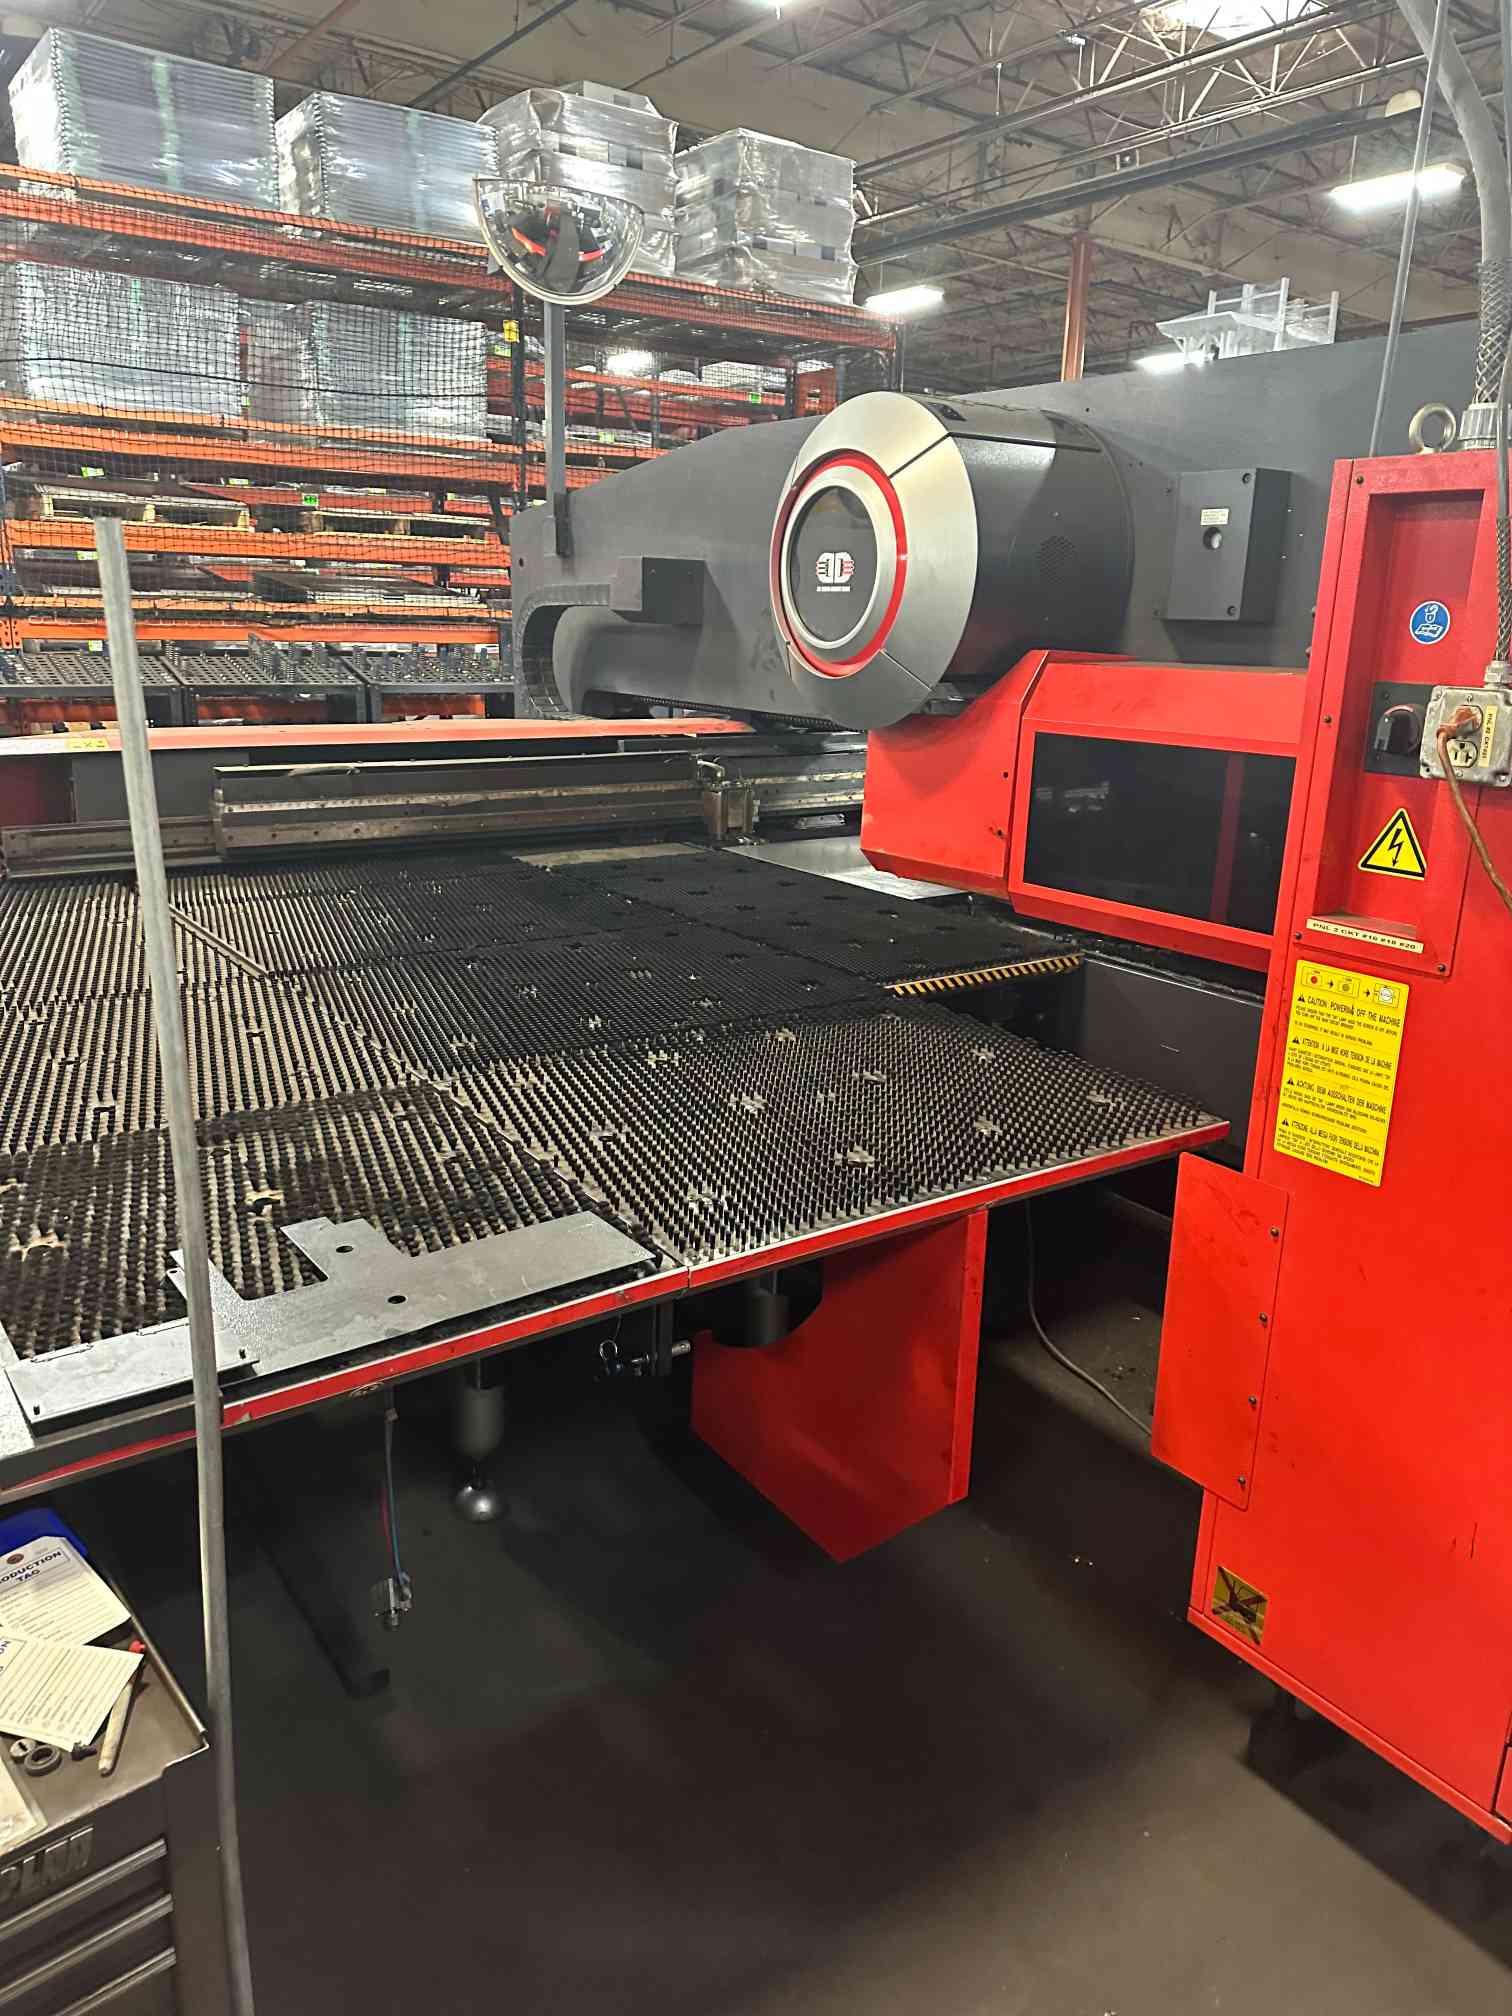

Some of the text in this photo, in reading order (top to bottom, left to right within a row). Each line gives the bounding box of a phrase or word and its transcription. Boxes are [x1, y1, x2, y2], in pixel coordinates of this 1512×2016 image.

[1312, 922, 1330, 931] PNL
[1340, 929, 1359, 937] CKT
[0, 1551, 62, 1583] ODUCTION
